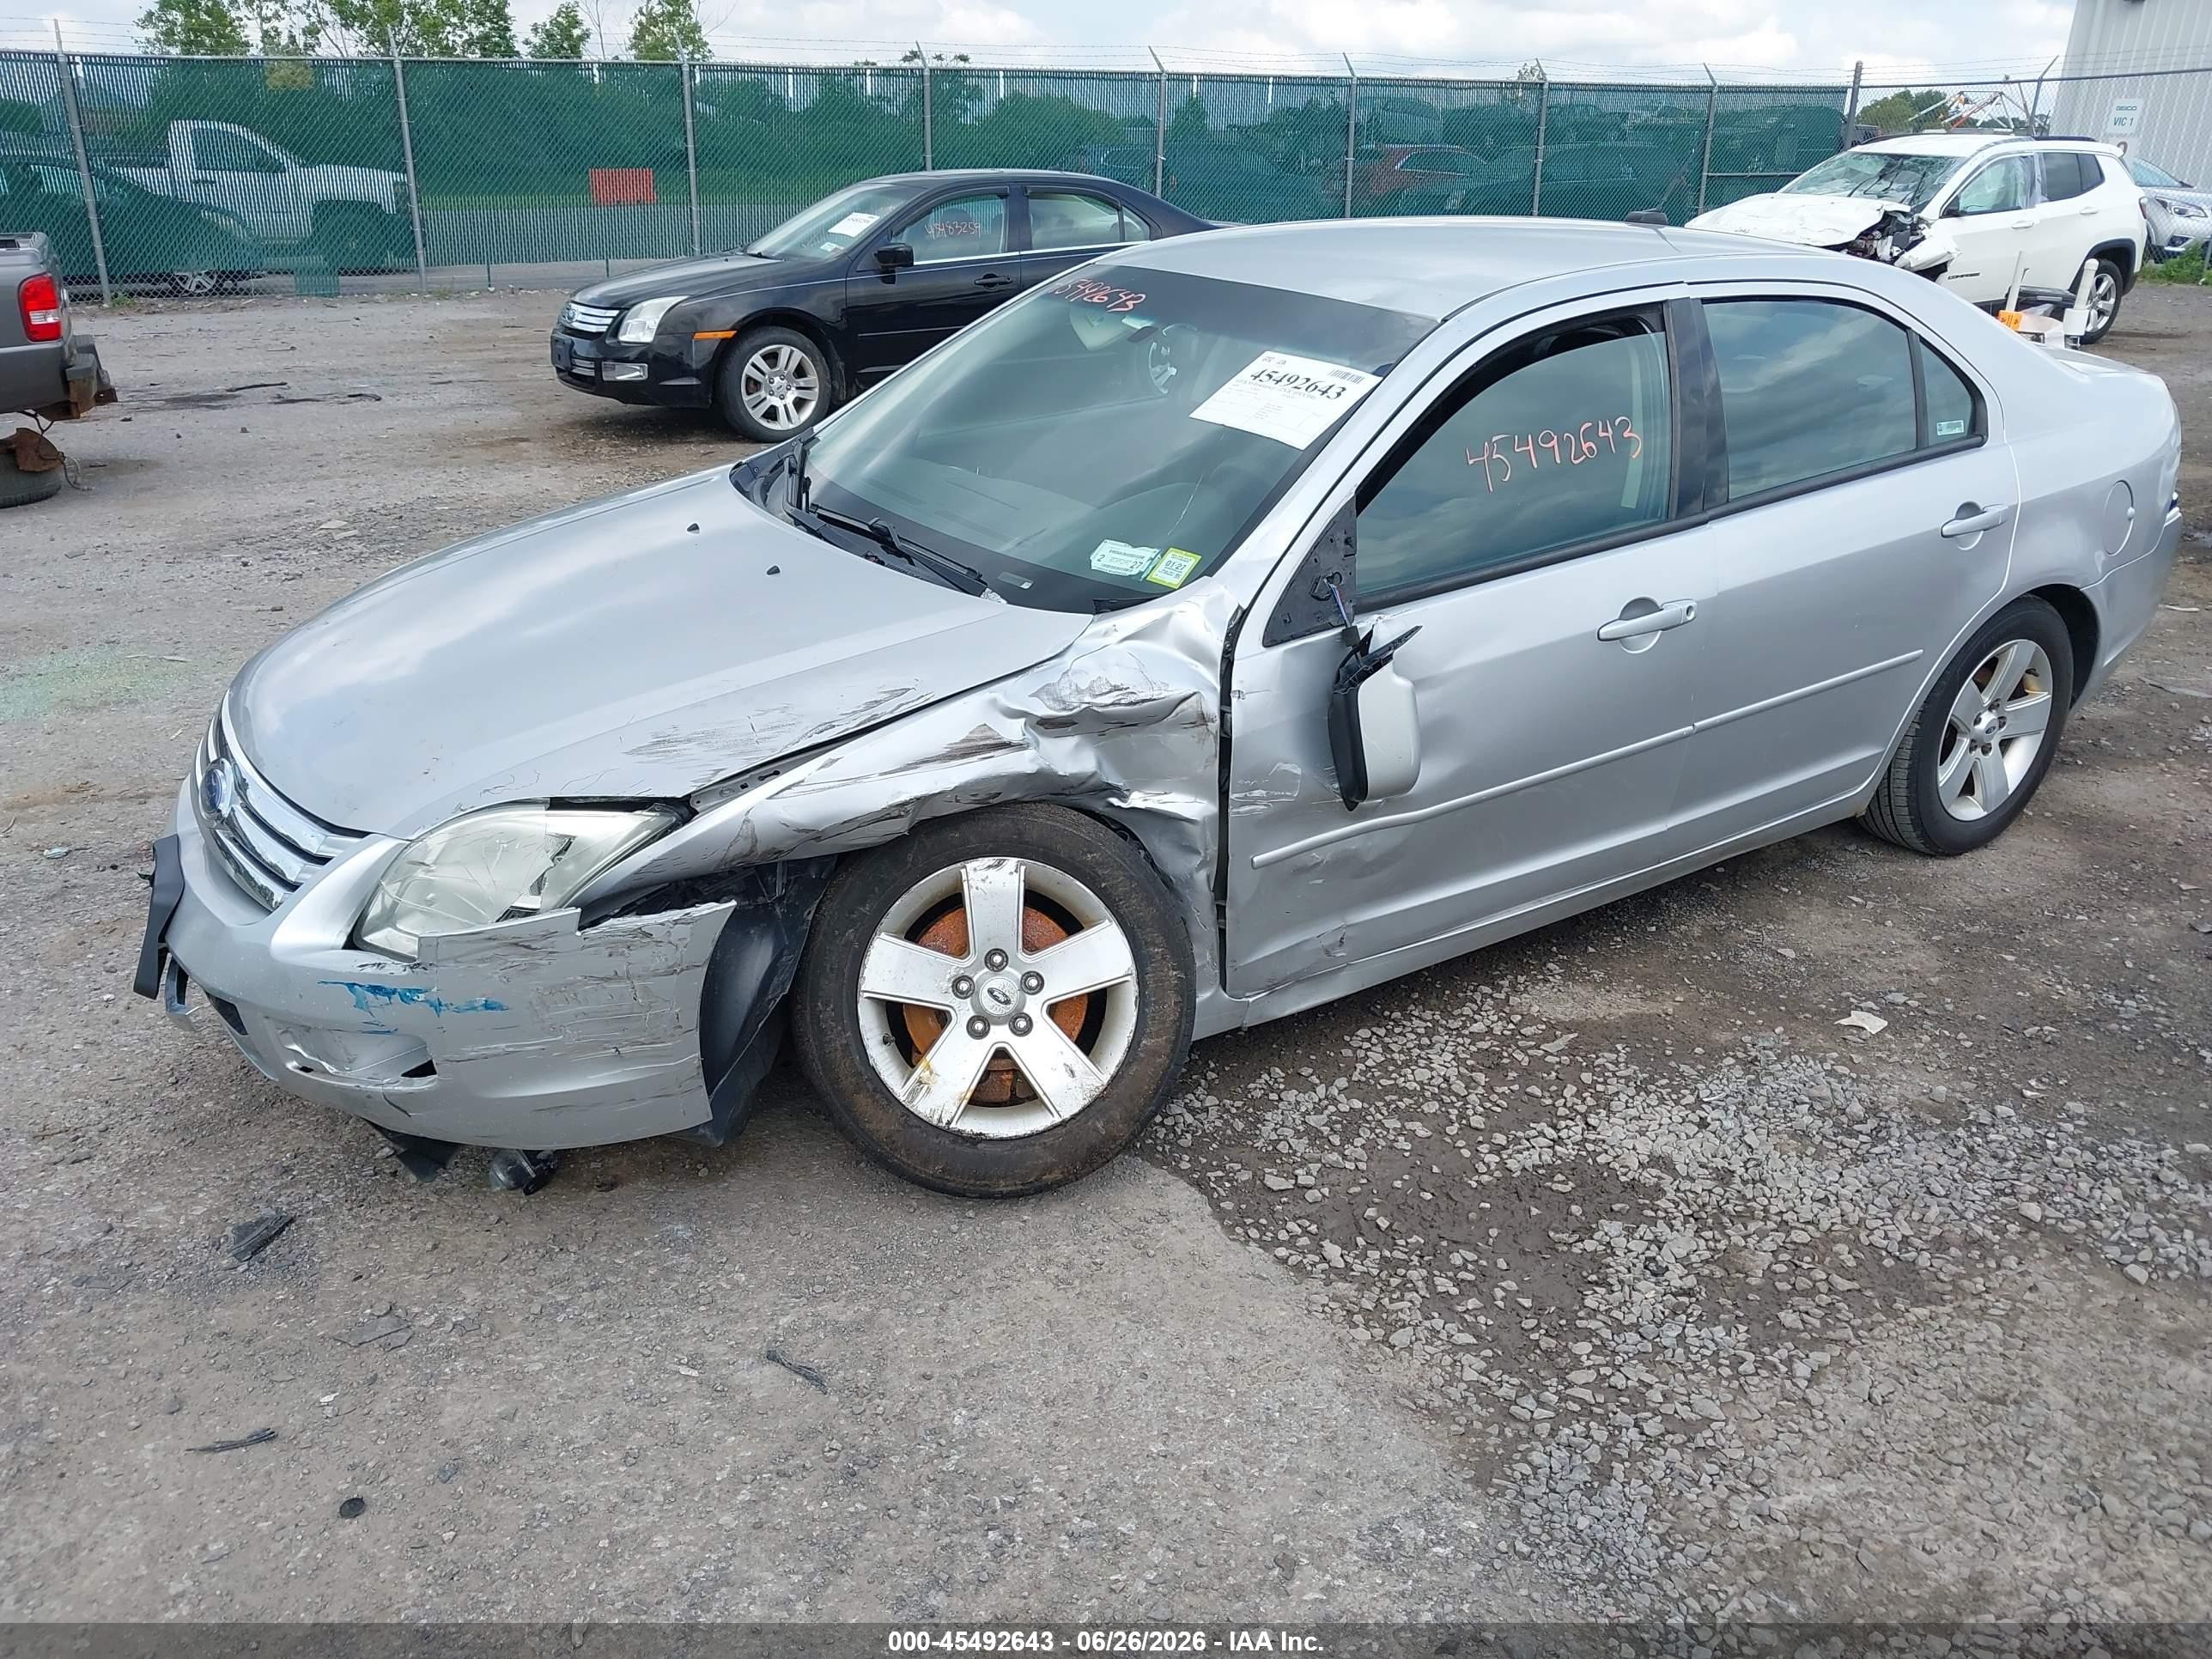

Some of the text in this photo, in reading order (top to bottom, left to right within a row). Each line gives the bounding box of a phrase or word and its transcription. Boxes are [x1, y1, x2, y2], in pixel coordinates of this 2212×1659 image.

[2113, 117, 2127, 126] VIC
[1250, 368, 1346, 400] 45492643
[1466, 416, 1642, 493] 45492643
